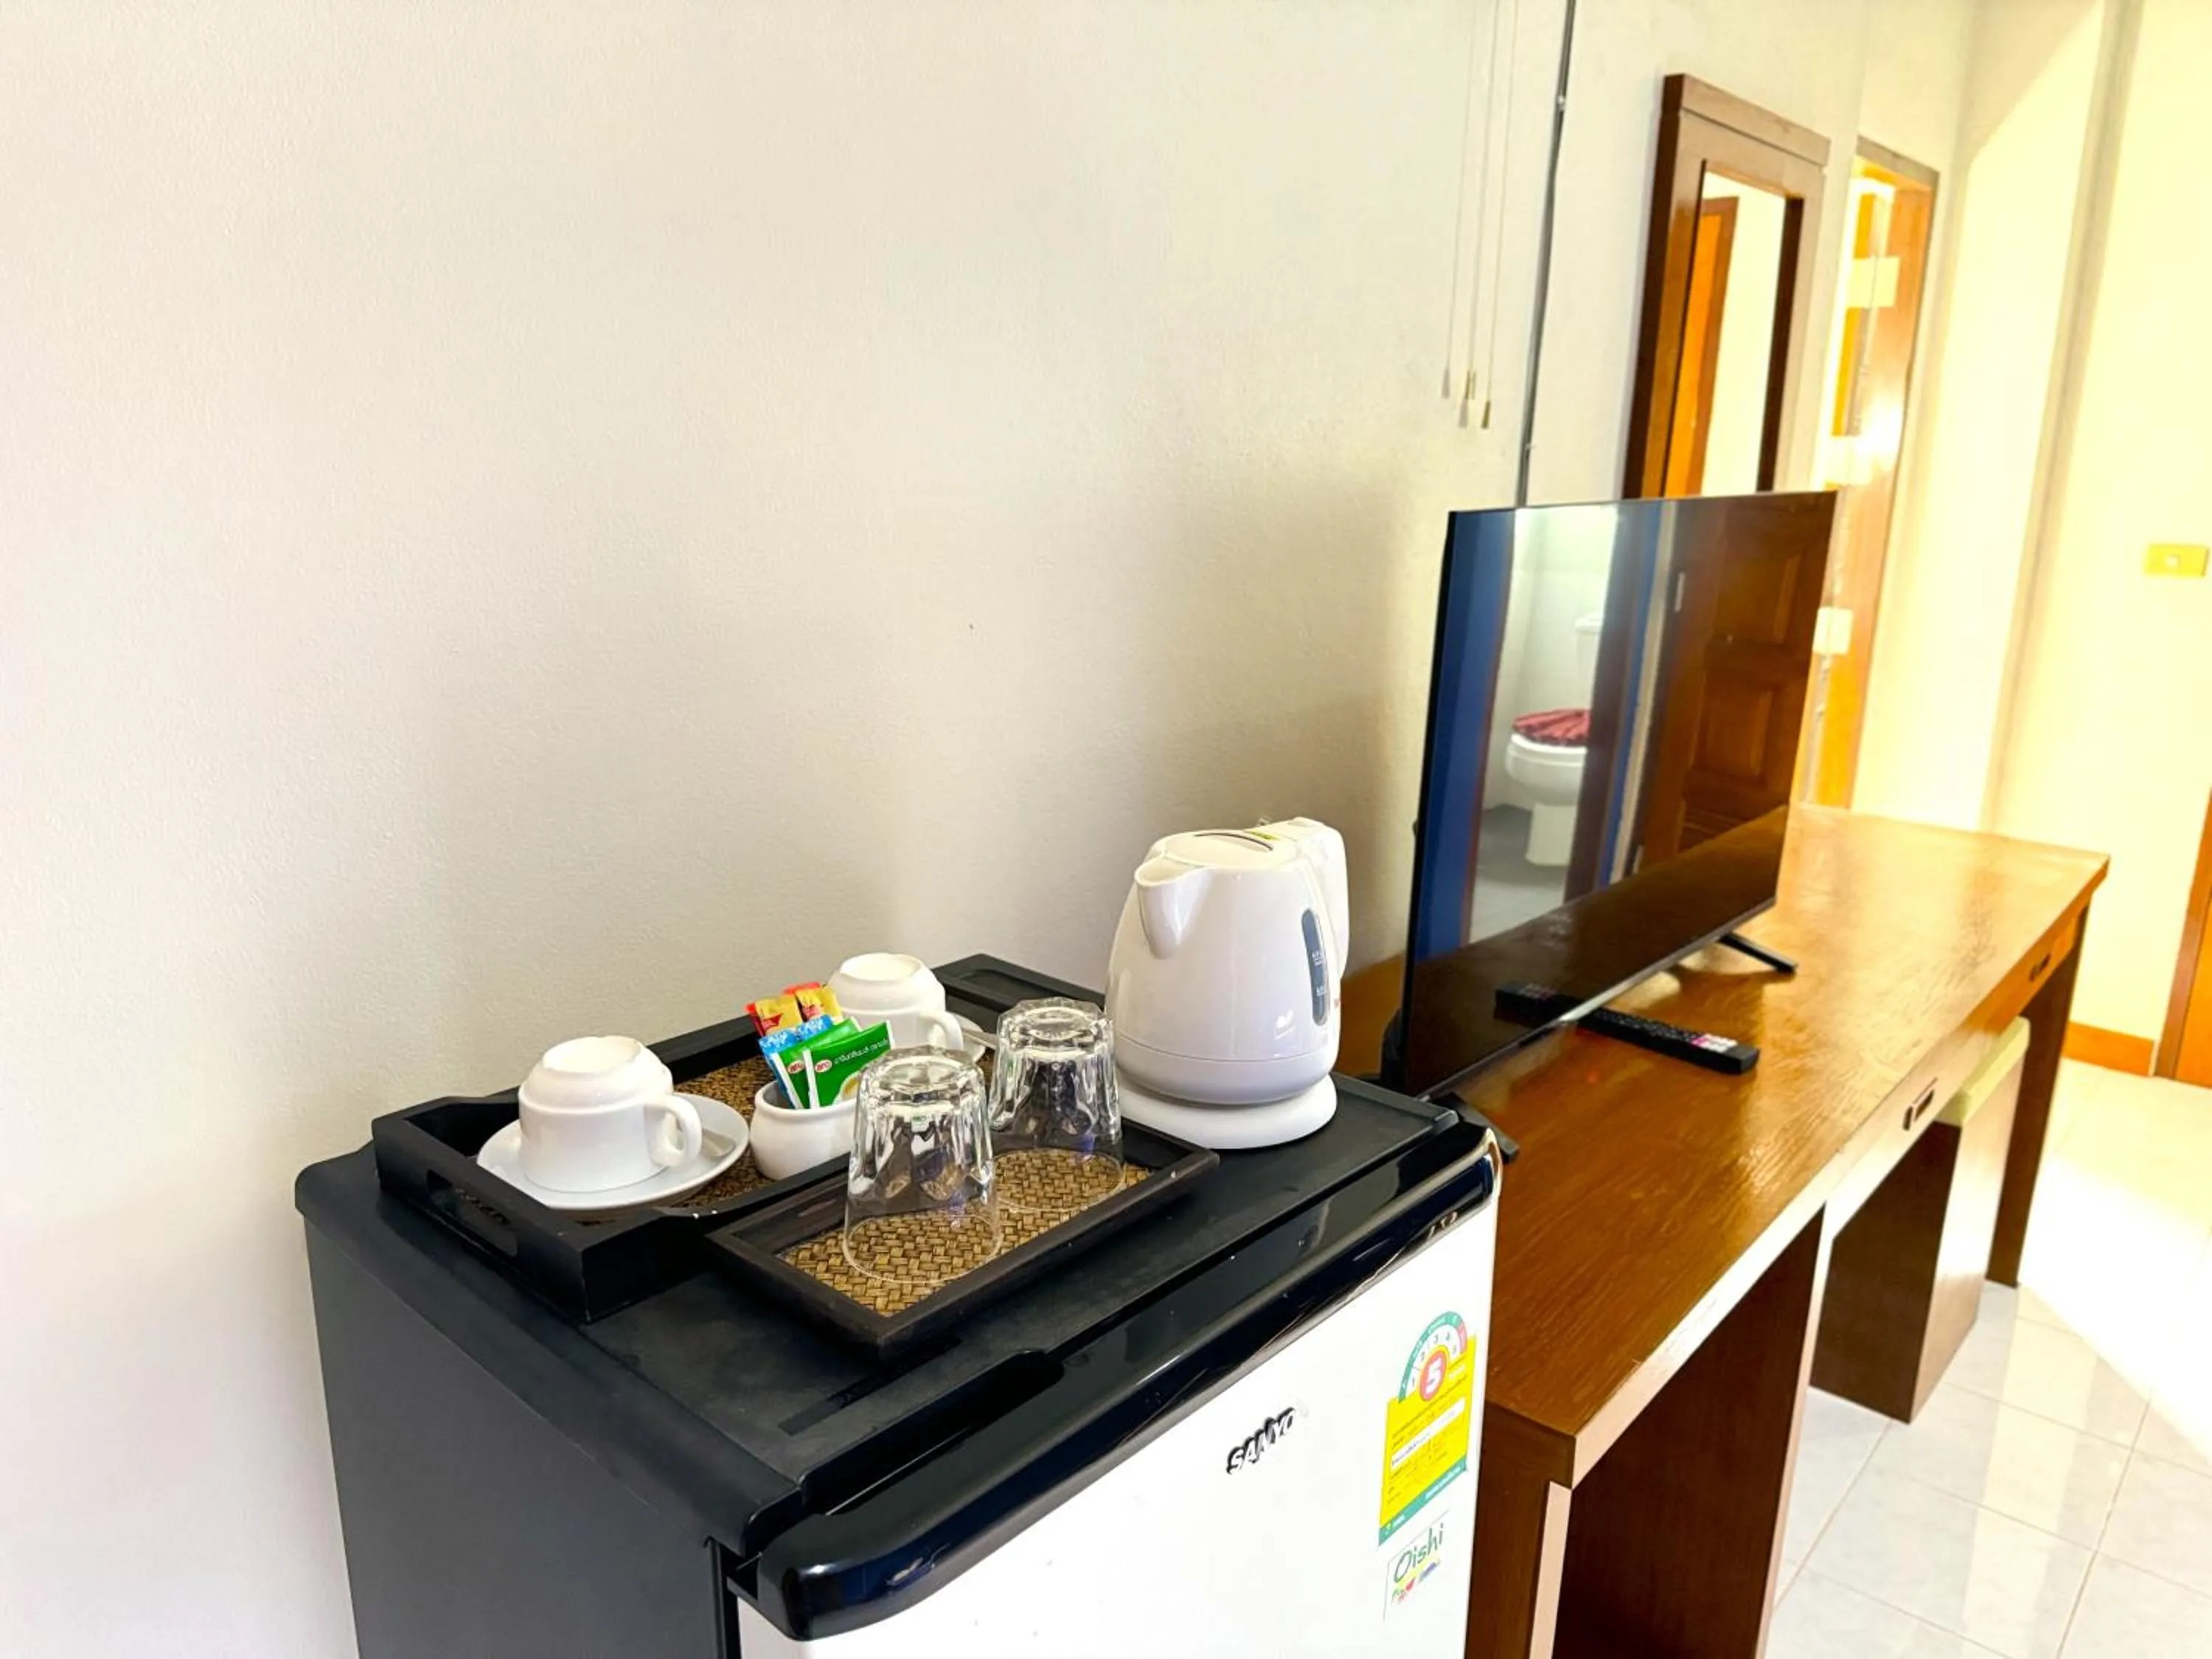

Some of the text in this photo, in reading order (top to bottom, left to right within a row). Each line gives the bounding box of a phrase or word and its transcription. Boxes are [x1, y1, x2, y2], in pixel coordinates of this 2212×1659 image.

[1425, 1355, 1442, 1394] 5
[1226, 1406, 1296, 1474] SANYO
[1394, 1523, 1444, 1583] Oishi
